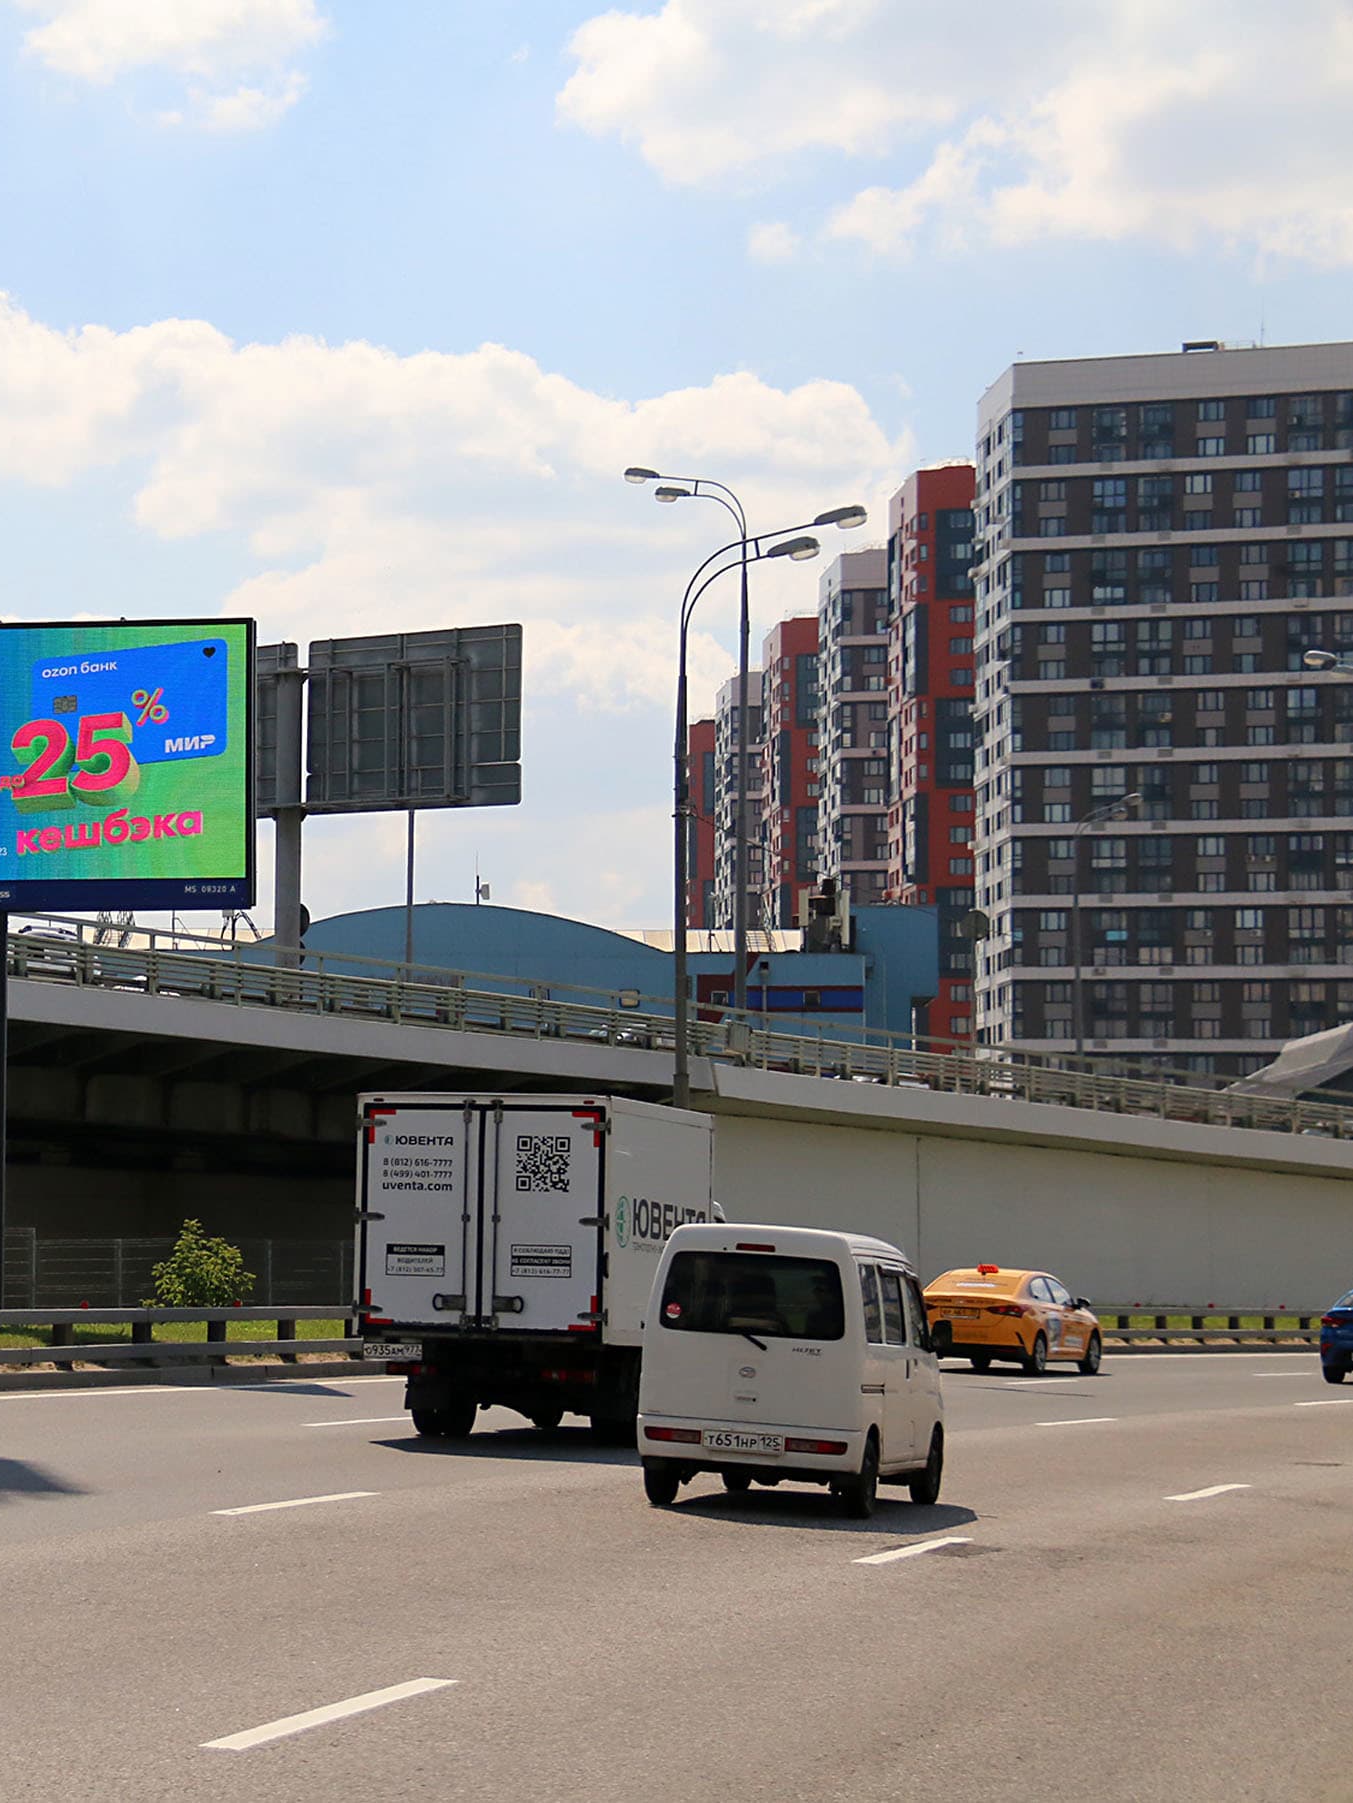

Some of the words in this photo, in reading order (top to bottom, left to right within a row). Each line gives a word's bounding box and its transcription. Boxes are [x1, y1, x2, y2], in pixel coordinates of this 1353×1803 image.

[41, 666, 78, 679] ozon
[80, 660, 118, 674] банк
[164, 734, 216, 753] МИР
[15, 807, 204, 855] кешбэка
[394, 1135, 454, 1146] ЮВЕНТА
[383, 1157, 389, 1167] 8
[390, 1157, 413, 1168] (812)
[414, 1158, 453, 1168] 616-7777
[382, 1169, 389, 1178] 8
[390, 1169, 413, 1179] (499)
[414, 1169, 453, 1179] 401-7777
[382, 1181, 453, 1192] uventa.com
